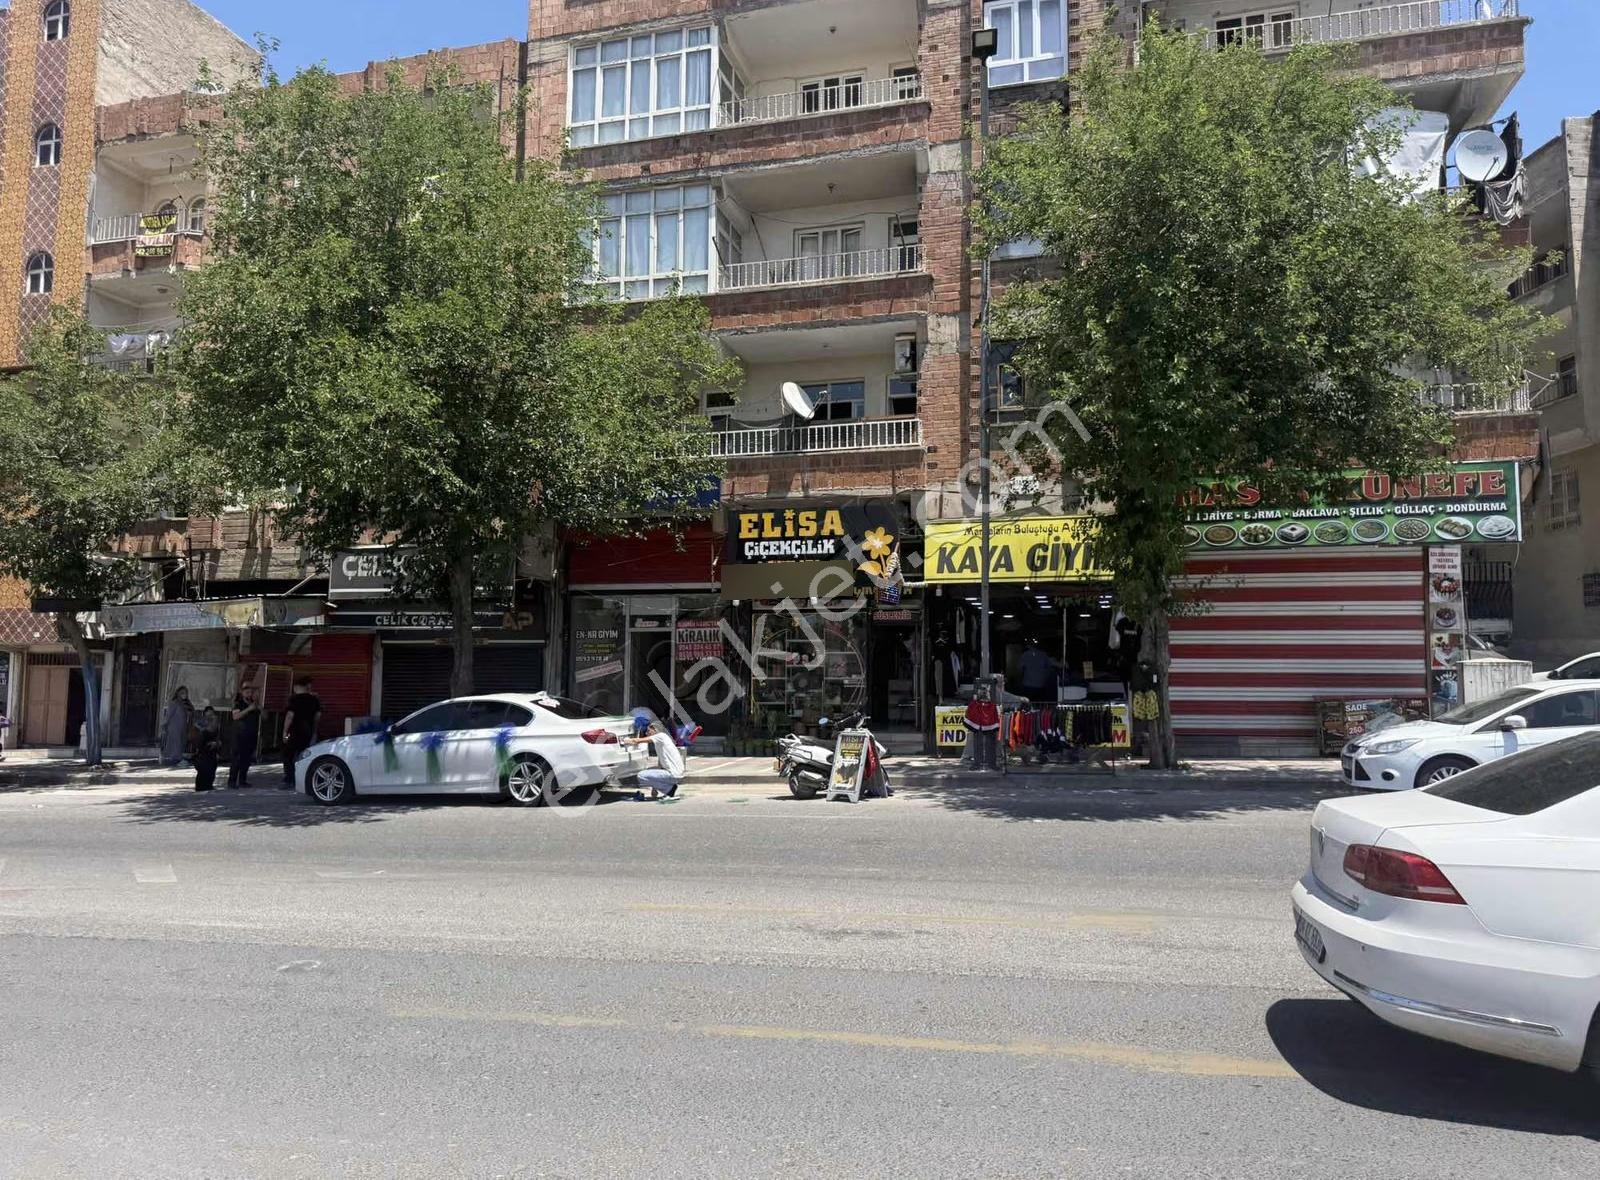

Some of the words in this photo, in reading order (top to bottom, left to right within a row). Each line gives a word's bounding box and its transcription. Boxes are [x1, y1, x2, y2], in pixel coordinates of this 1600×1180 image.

[1292, 507, 1340, 518] BAKLAVA
[1349, 505, 1384, 517] ŞILLIK
[1394, 503, 1436, 516] GÜLLAÇ
[1446, 501, 1508, 513] DONDURMA
[1014, 523, 1059, 536] Buluştuğu
[936, 545, 1014, 574] KAYA
[1345, 703, 1368, 712] SADE
